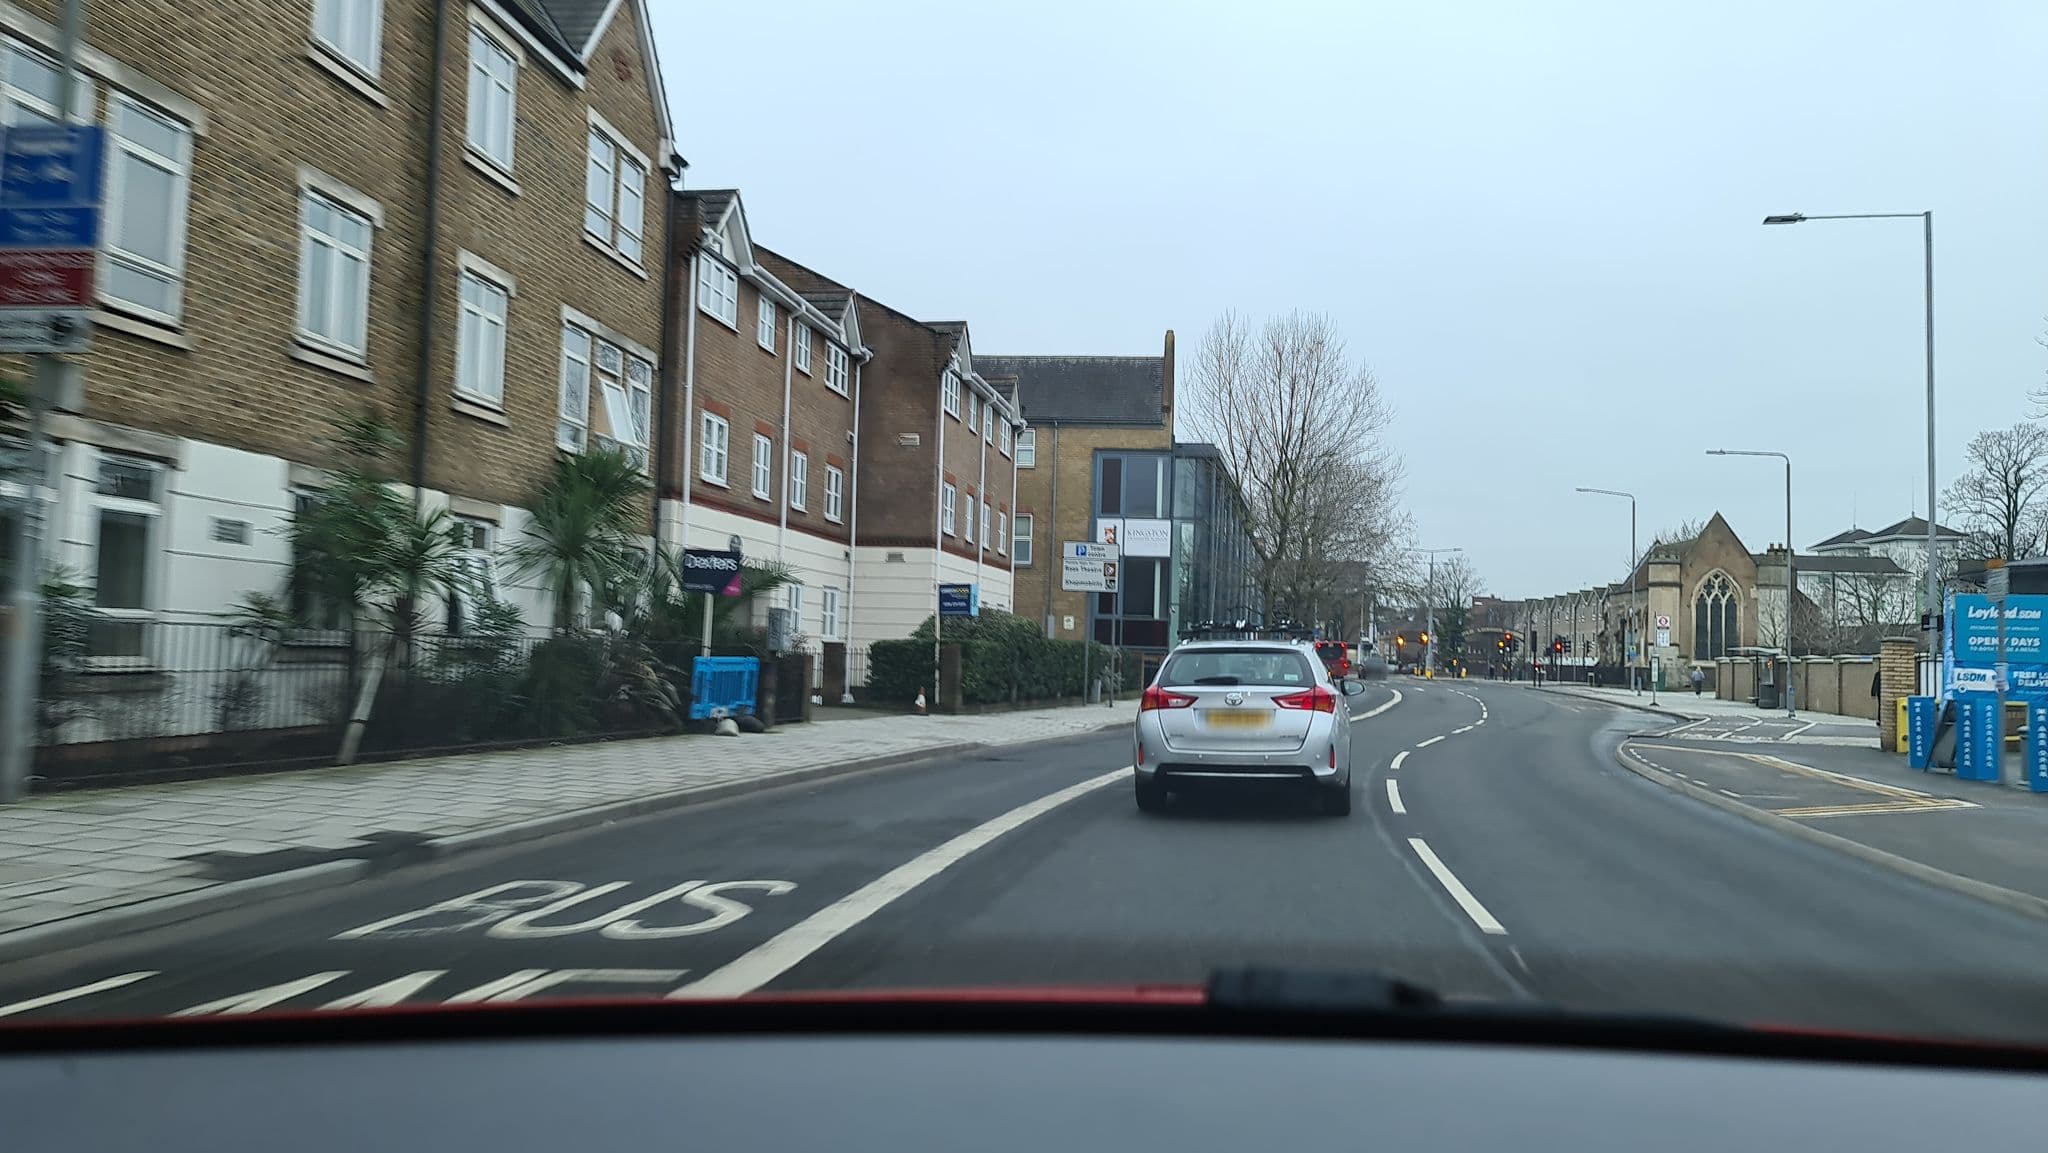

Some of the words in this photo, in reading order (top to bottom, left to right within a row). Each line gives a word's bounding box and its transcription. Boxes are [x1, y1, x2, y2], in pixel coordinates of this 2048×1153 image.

[1127, 529, 1168, 537] KINGSTON
[685, 553, 738, 571] Dexters
[1968, 636, 1999, 646] OPEN
[2010, 637, 2041, 647] DAYS
[1956, 672, 1987, 682] LSDM
[331, 879, 798, 939] BUS
